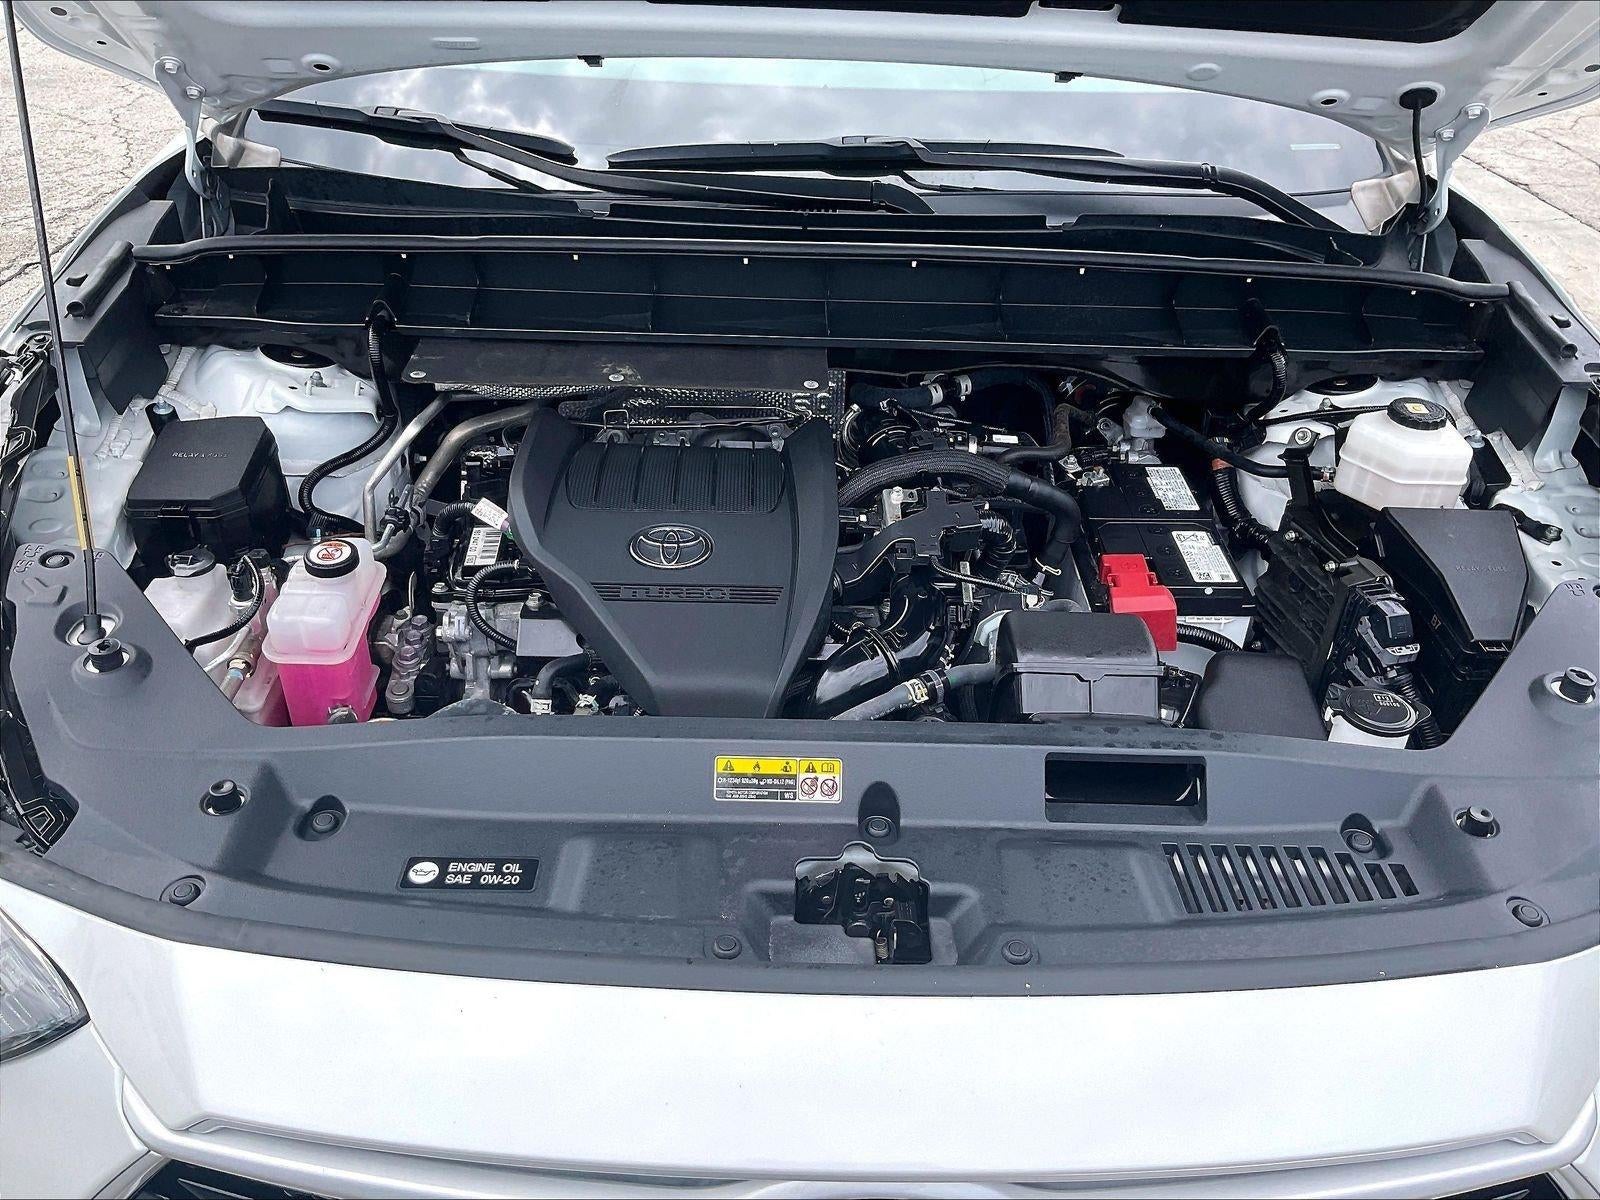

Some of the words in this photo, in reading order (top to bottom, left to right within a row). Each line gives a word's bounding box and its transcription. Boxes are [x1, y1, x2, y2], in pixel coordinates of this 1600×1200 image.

[620, 586, 730, 600] TURBO
[447, 862, 496, 873] ENGINE
[502, 863, 523, 873] OIL
[444, 874, 473, 885] SAE
[480, 874, 521, 886] 0W-20
